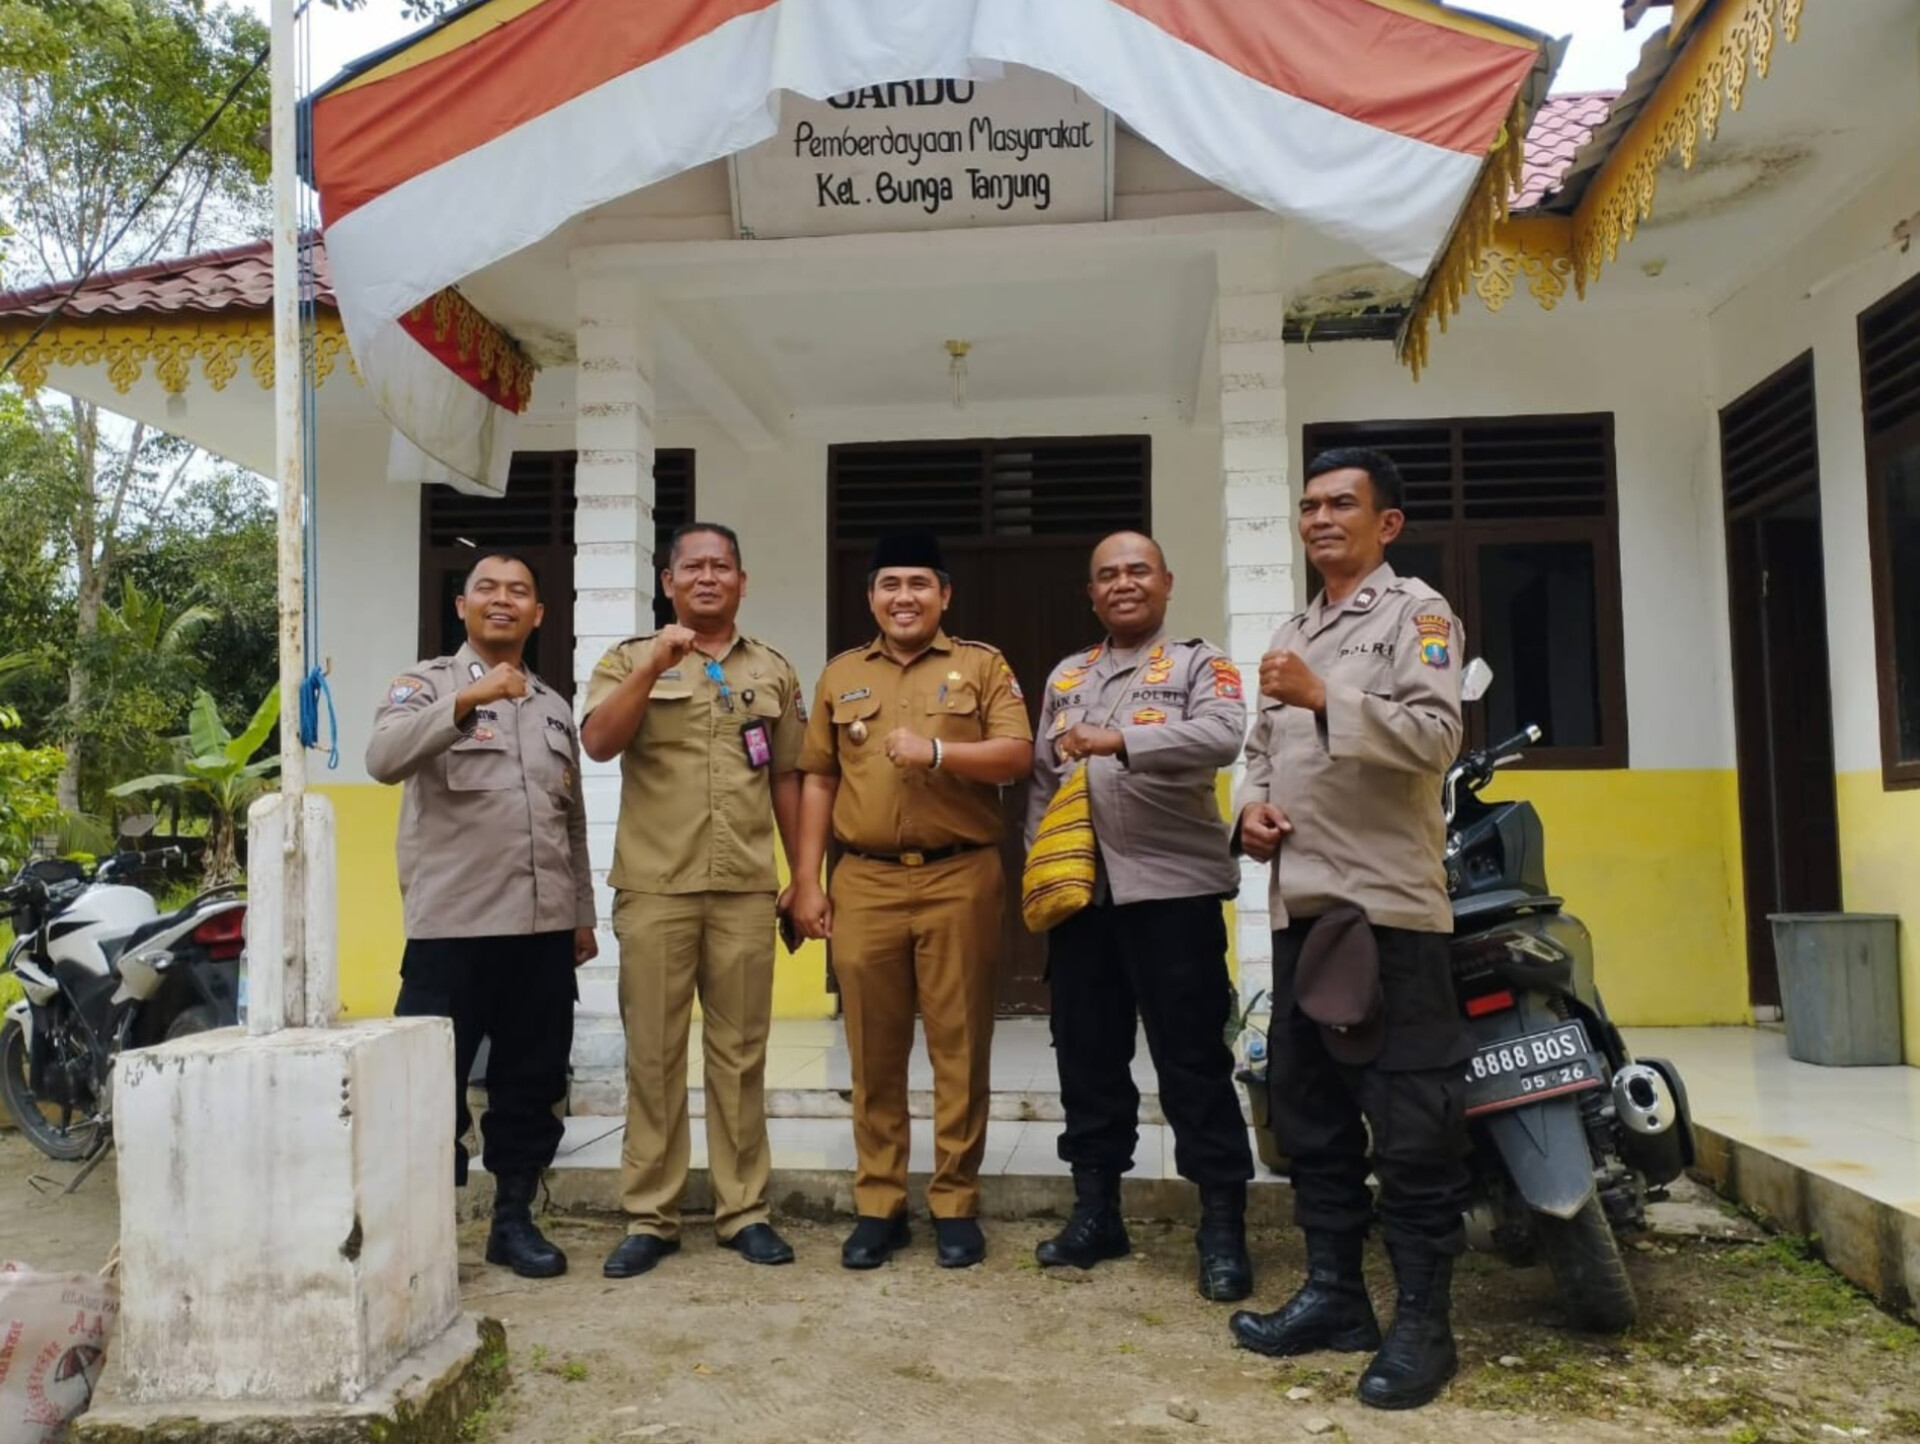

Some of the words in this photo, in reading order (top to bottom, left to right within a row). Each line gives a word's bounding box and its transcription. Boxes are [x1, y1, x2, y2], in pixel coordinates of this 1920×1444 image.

[794, 120, 962, 166] Pemberdayaan
[969, 116, 1094, 161] Masyarakat
[876, 171, 953, 214] Bunga
[965, 168, 1050, 210] Tanjung
[1472, 1045, 1528, 1079] 8888
[1531, 1035, 1577, 1065] BOS
[1521, 1074, 1546, 1092] 05
[1559, 1066, 1584, 1083] 26
